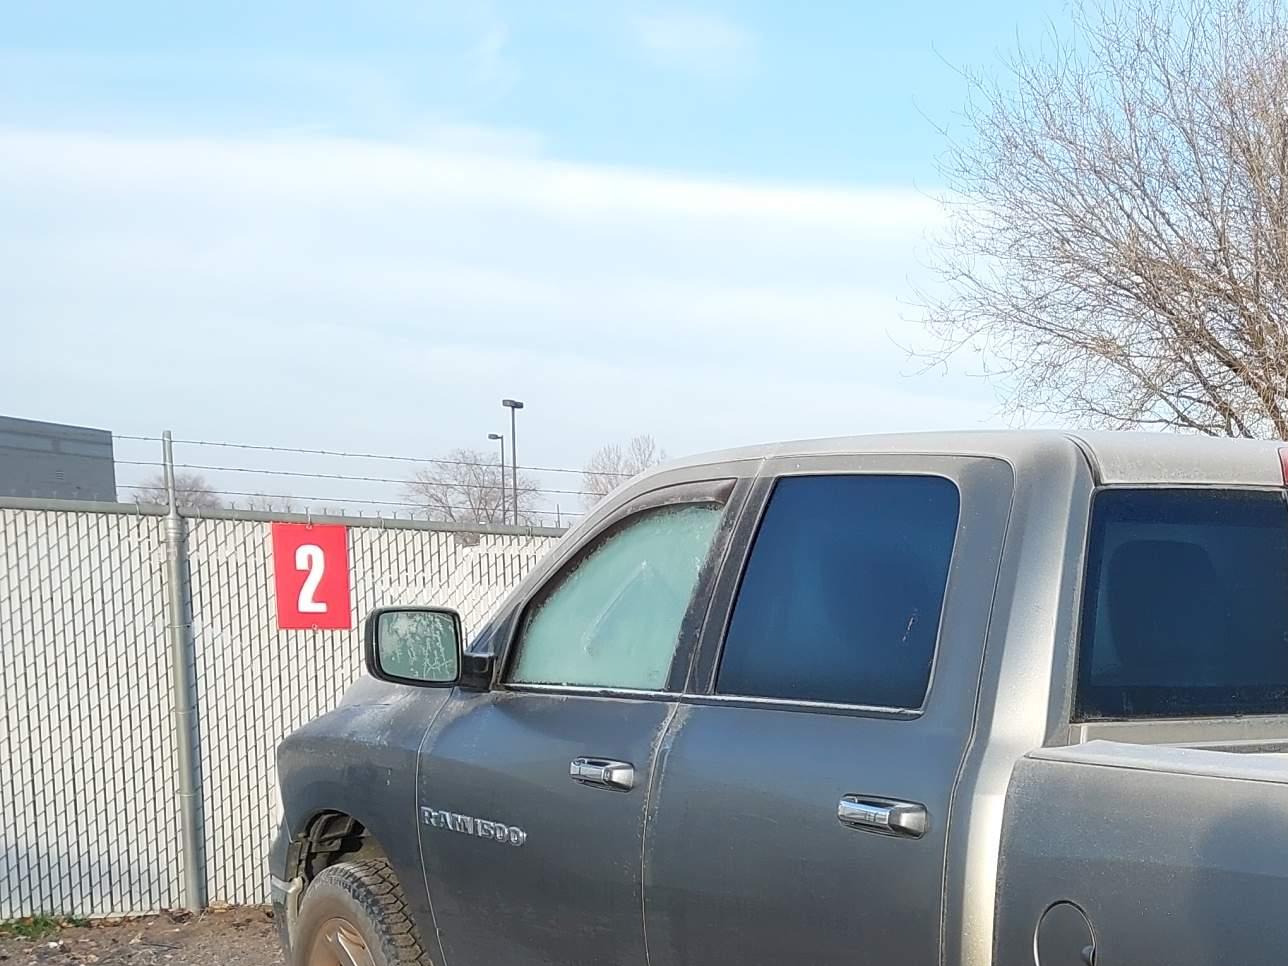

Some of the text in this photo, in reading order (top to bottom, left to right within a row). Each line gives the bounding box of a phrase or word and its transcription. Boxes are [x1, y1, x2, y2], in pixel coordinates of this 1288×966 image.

[295, 544, 328, 613] 2
[420, 806, 527, 846] RAM 1500
